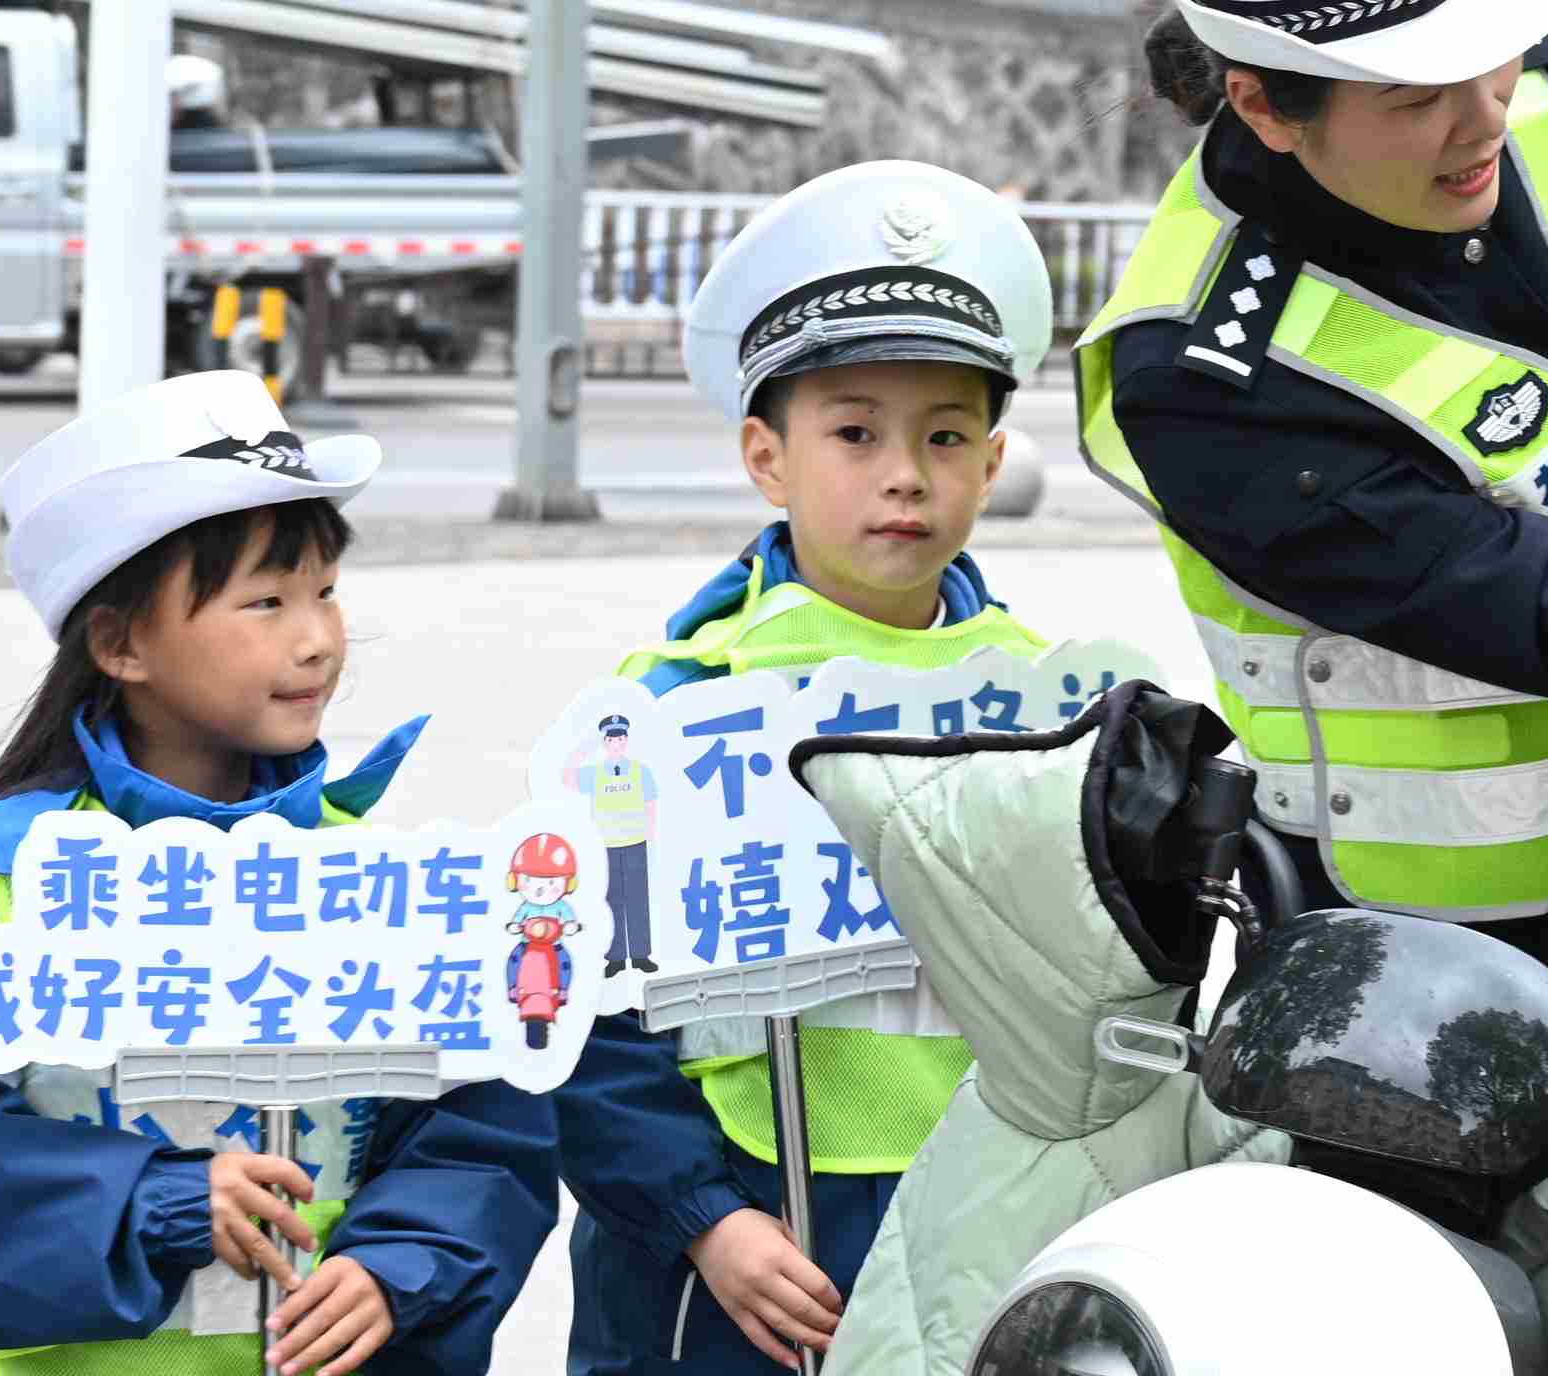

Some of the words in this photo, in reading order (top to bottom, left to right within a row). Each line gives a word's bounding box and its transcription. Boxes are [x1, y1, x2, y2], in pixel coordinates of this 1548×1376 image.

[39, 836, 491, 933] 乘坐电动车
